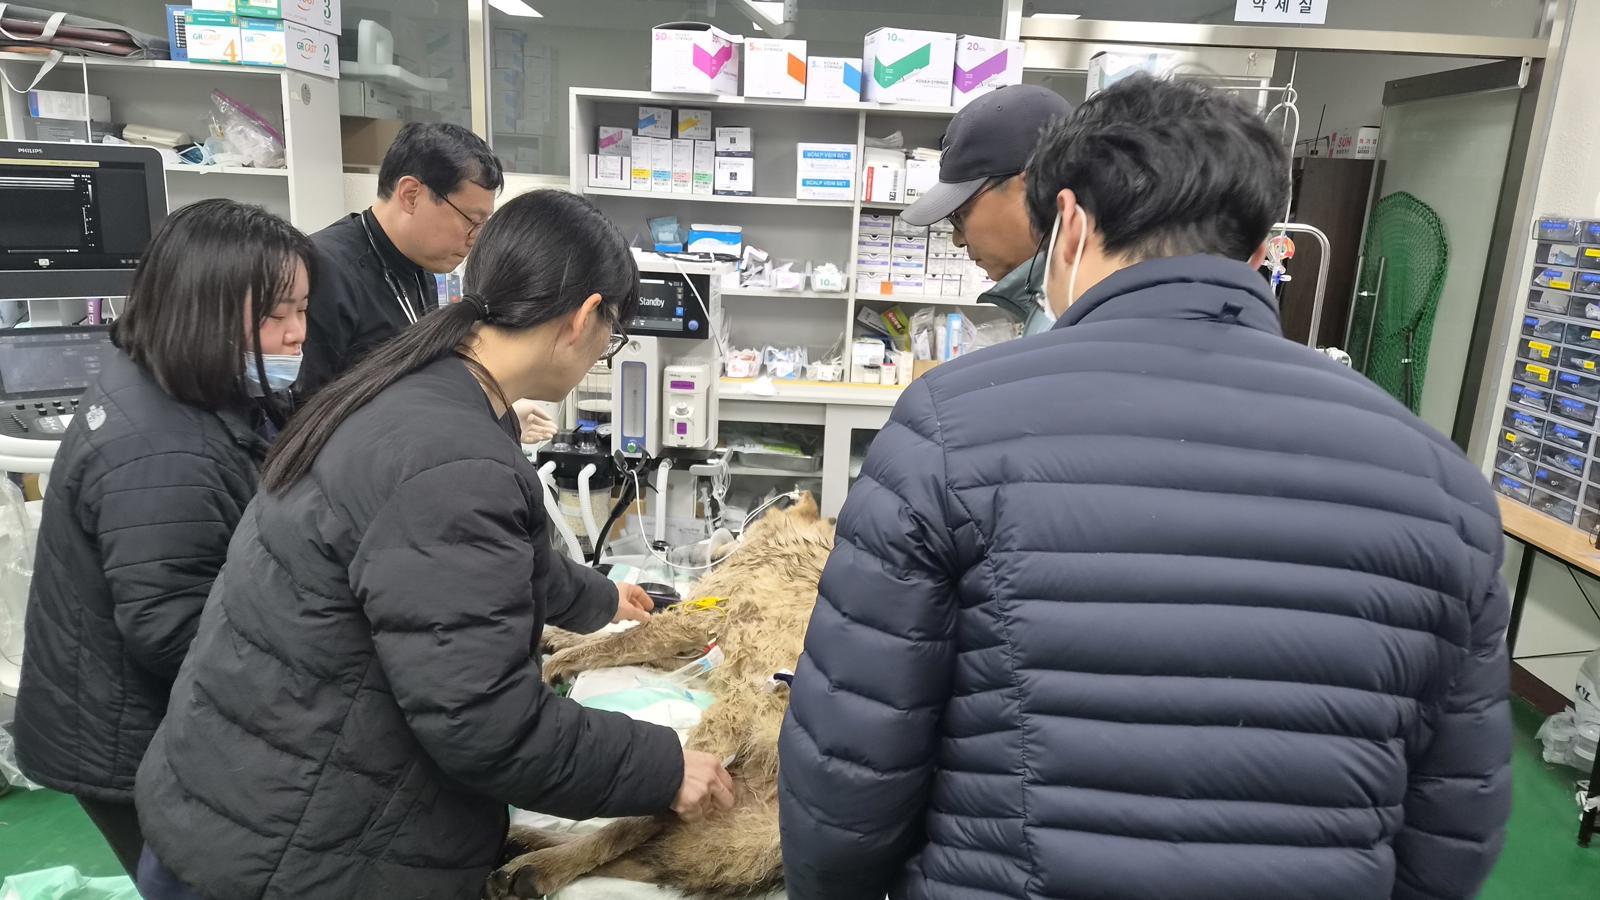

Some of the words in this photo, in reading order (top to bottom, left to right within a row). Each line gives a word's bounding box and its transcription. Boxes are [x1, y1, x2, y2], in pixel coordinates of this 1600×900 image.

[223, 39, 238, 64] 4
[324, 43, 331, 65] 2
[639, 296, 665, 308] Standby
